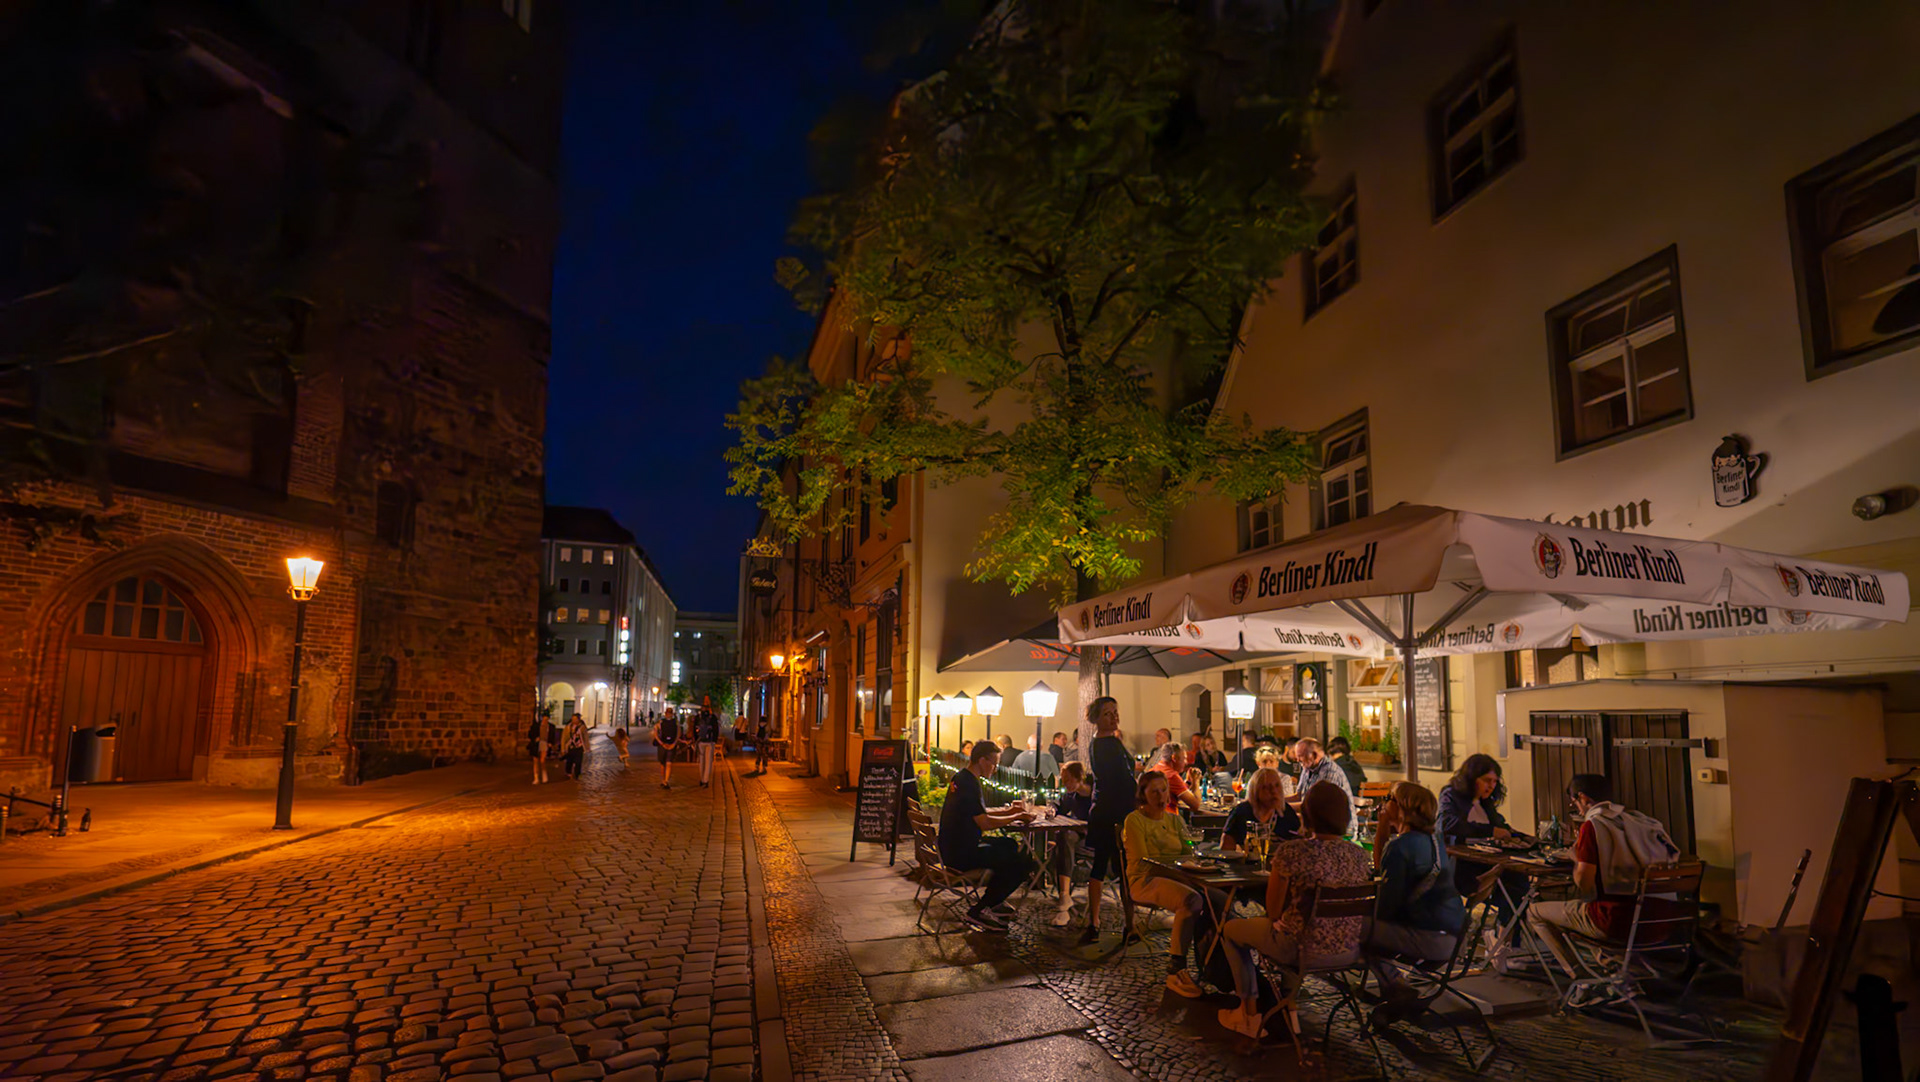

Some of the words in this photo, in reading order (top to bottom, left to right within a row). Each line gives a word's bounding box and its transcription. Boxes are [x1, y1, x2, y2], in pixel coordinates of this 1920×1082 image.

[1257, 561, 1321, 598] Berliner
[1321, 541, 1378, 587] Kindl
[1567, 537, 1641, 580] Berliner
[1633, 544, 1686, 585] Kindl
[1795, 566, 1853, 600] Berliner
[1845, 572, 1885, 606] Kindl
[1093, 602, 1125, 628] Berliner
[1125, 592, 1153, 622] Kindl
